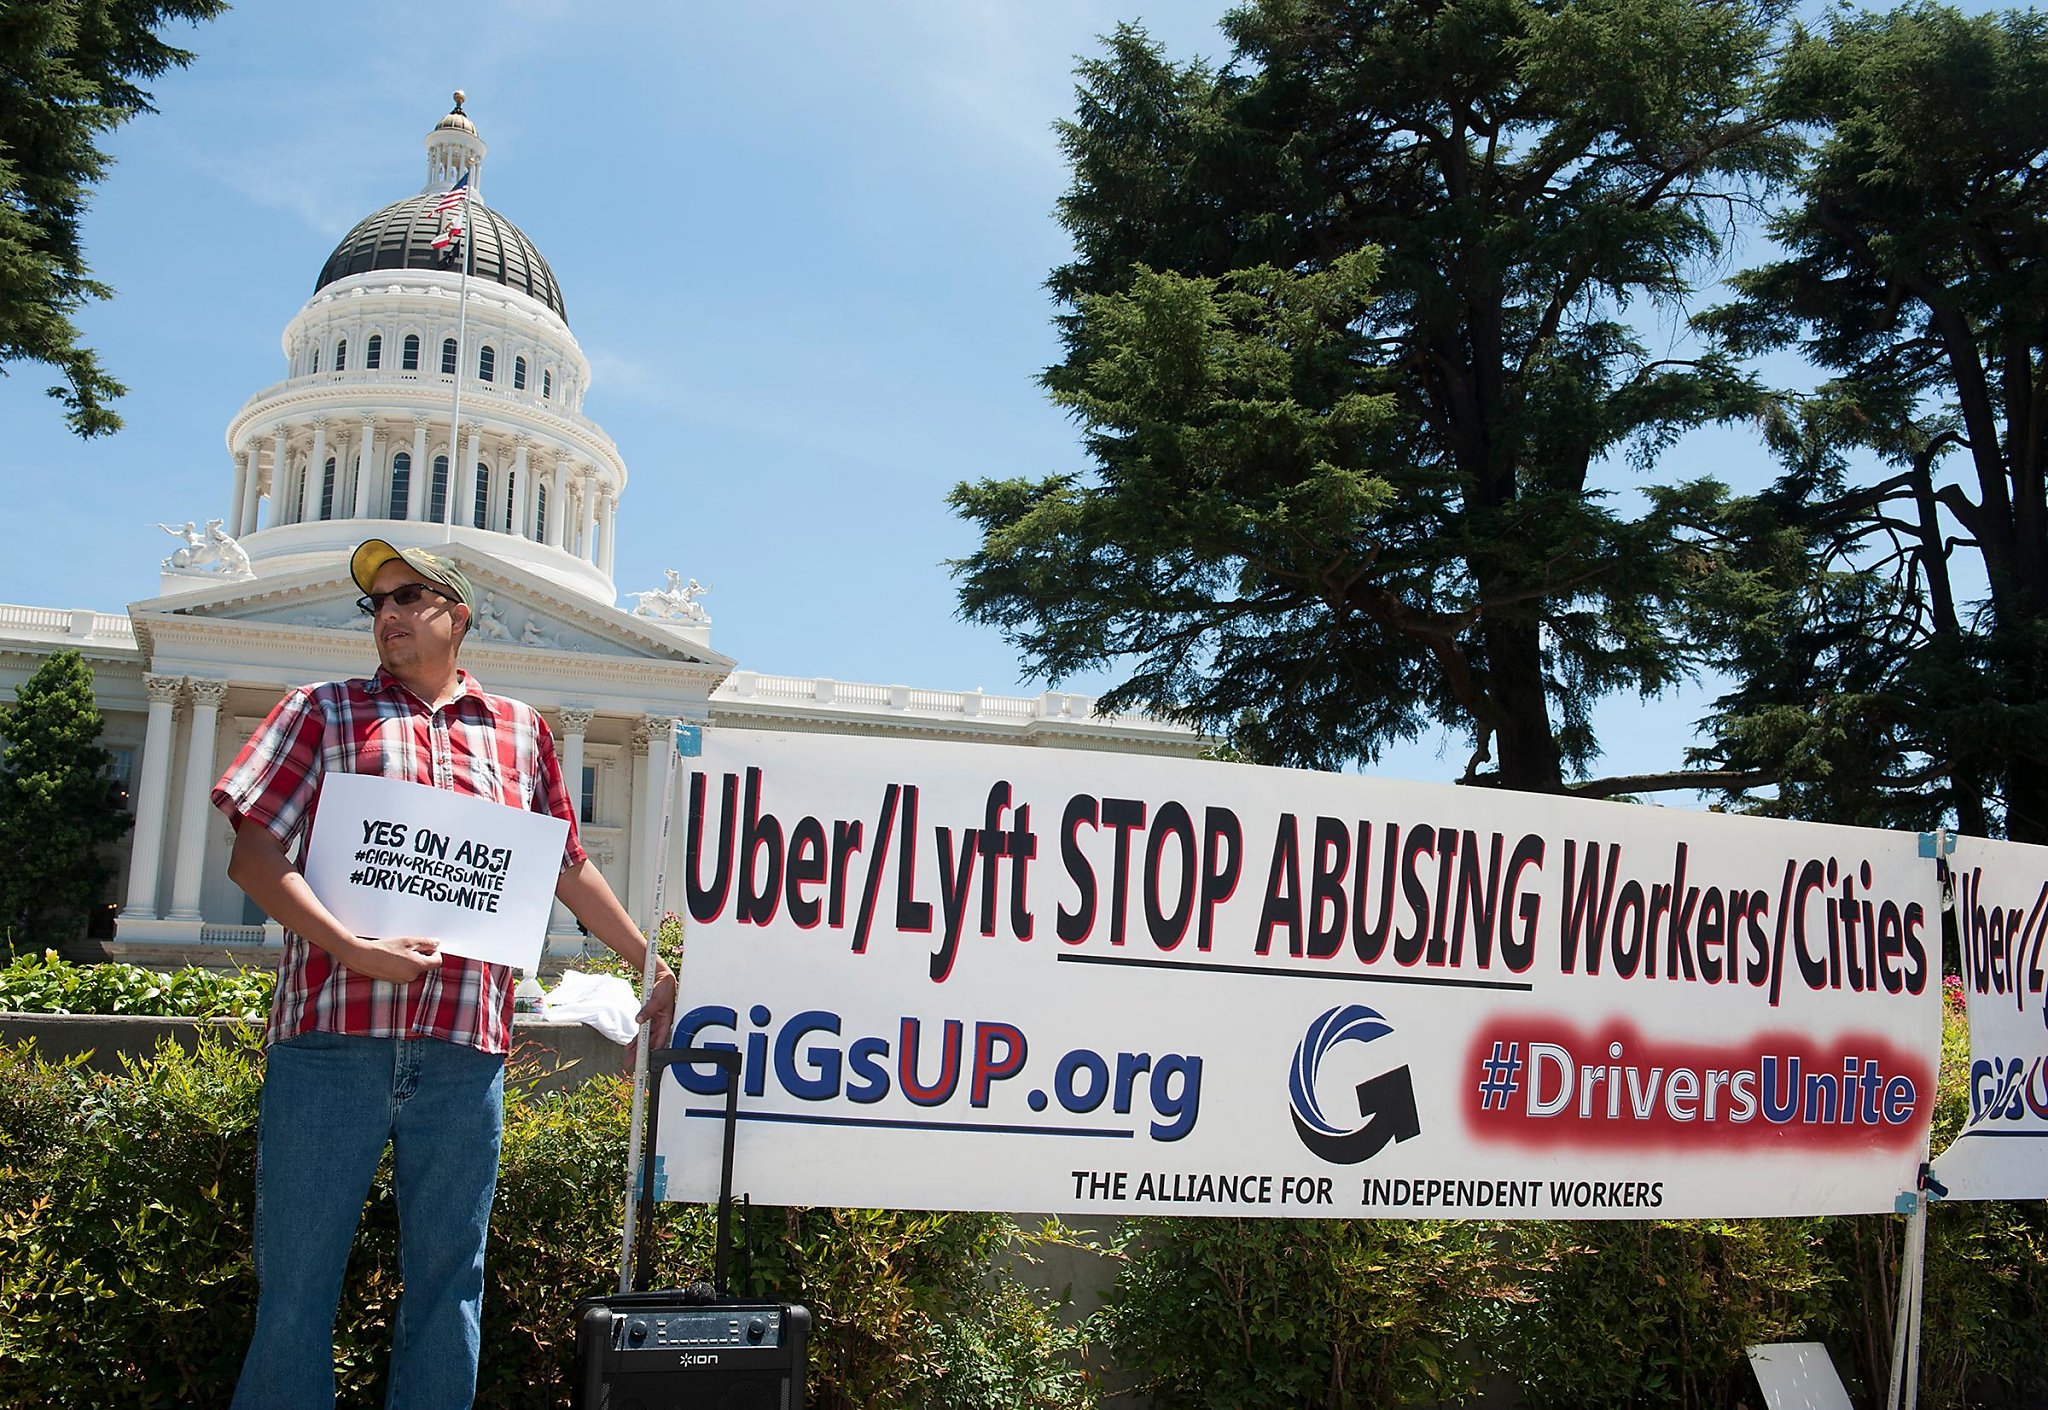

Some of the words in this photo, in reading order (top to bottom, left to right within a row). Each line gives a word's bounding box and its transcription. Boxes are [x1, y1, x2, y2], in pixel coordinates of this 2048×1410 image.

[362, 819, 408, 848] YES
[414, 828, 450, 860] ON
[685, 767, 1037, 983] Uber/Lyft
[1056, 793, 1243, 951] STOP
[1254, 813, 1546, 974] ABUSING
[1559, 840, 1927, 1007] Workers/Cities
[671, 1004, 1203, 1142] GiGsUP.org
[1478, 1040, 1915, 1126] #DriversUnite
[1071, 1171, 1128, 1200] THE
[1135, 1172, 1272, 1204] ALLIANCE
[1281, 1176, 1334, 1205] FOR
[1361, 1178, 1543, 1208] INDEPENDENT
[1550, 1181, 1664, 1208] WORKERS
